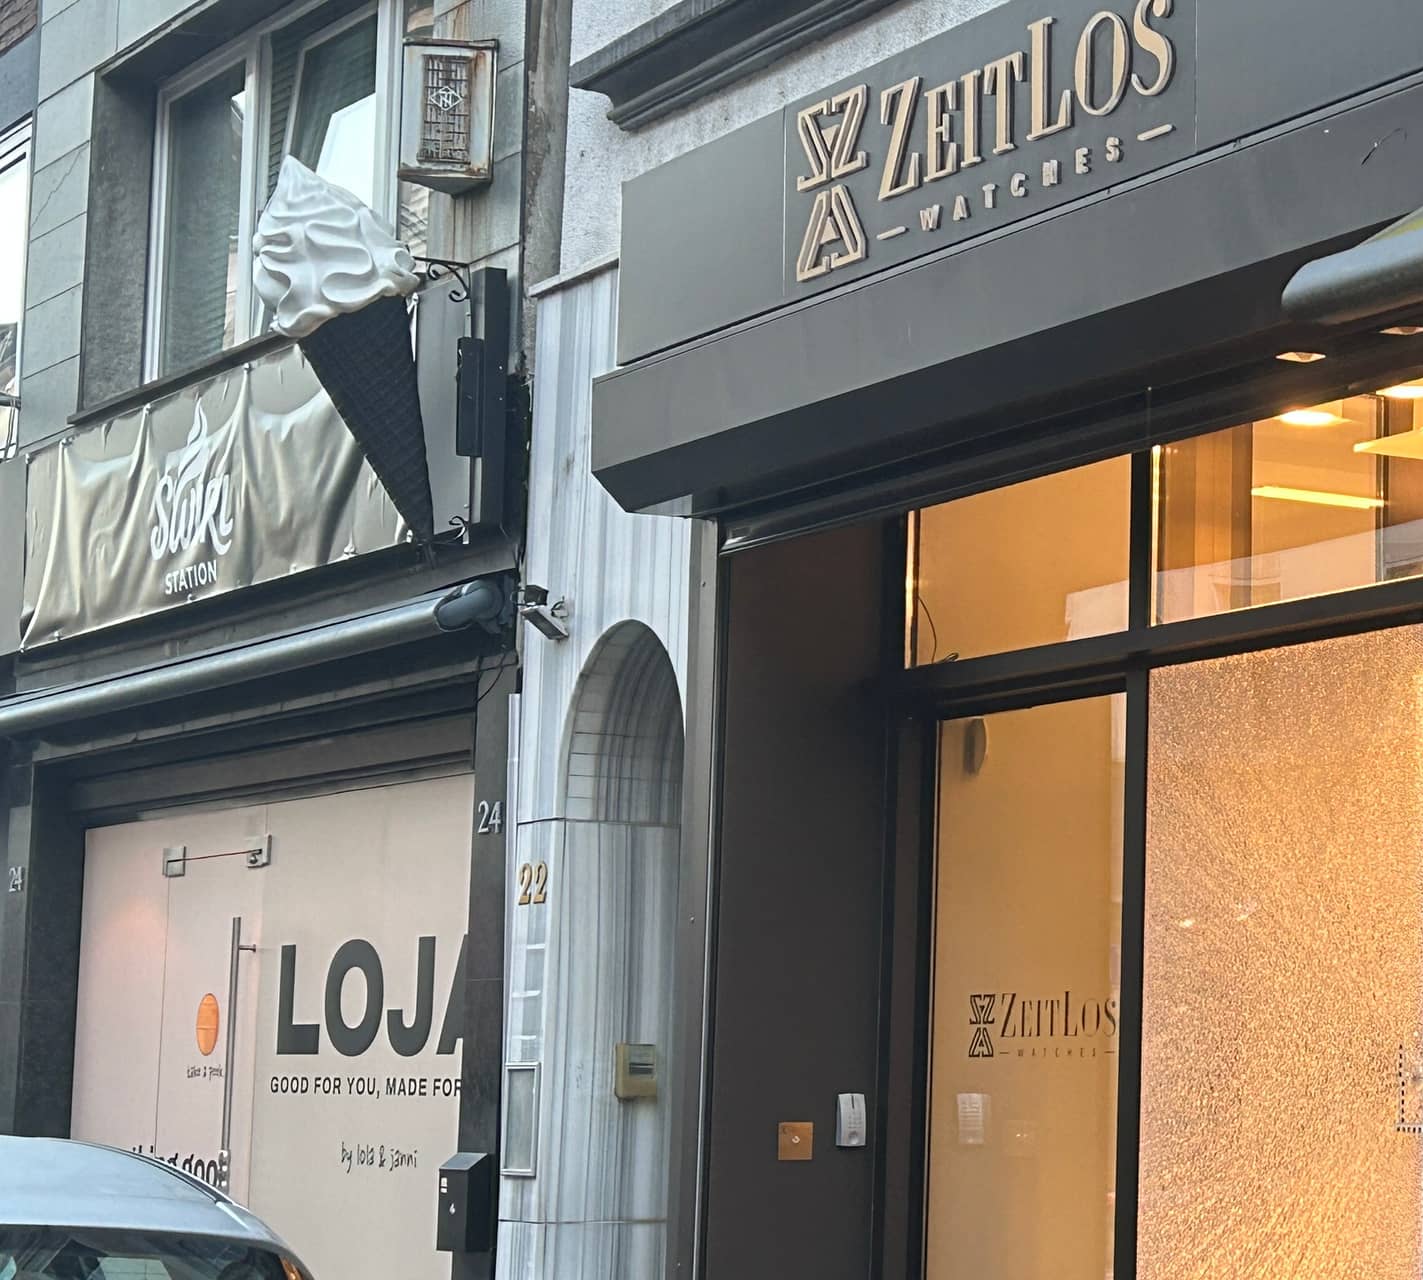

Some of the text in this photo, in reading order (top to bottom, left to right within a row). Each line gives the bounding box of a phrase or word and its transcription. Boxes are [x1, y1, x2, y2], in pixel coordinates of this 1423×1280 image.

[919, 136, 1121, 232] WATCHES
[165, 560, 217, 595] STATION
[478, 800, 502, 834] 24
[8, 866, 23, 892] 24
[518, 861, 548, 905] 22
[271, 1076, 309, 1094] GOOD
[314, 1077, 341, 1095] FOR
[347, 1077, 380, 1099] YOU,
[386, 1078, 427, 1096] MADE
[341, 1141, 418, 1173] by lola & janni
